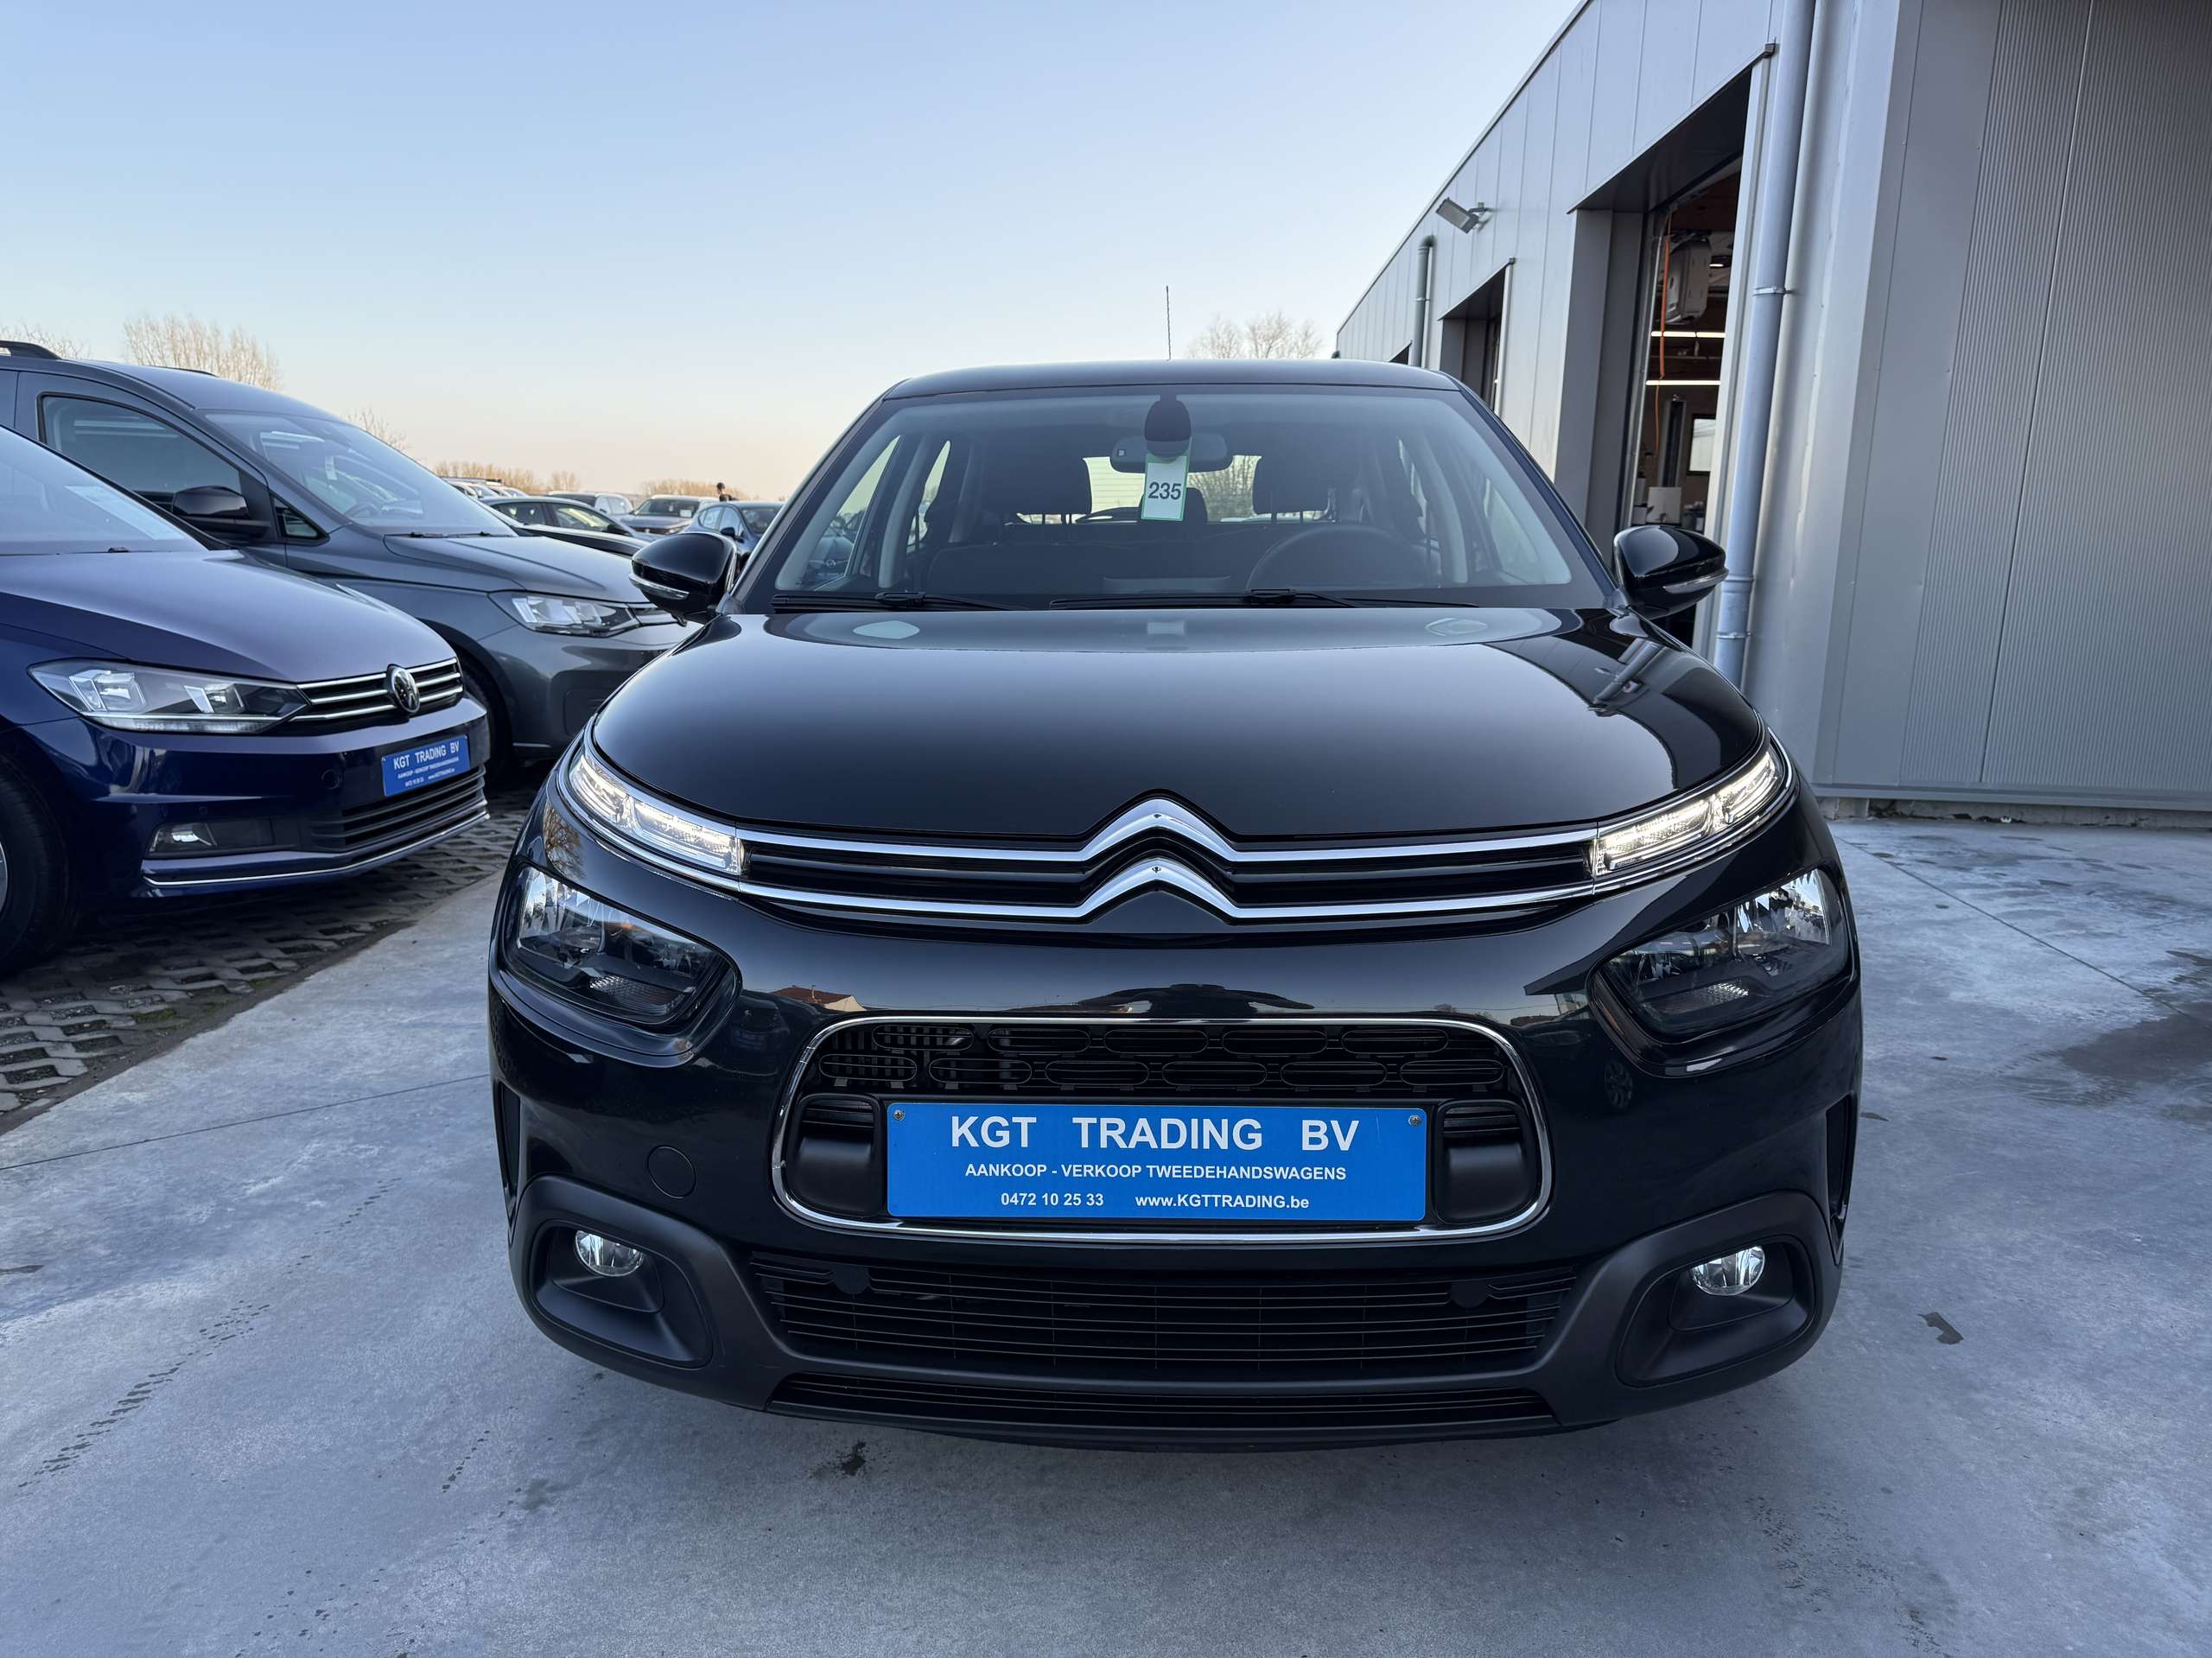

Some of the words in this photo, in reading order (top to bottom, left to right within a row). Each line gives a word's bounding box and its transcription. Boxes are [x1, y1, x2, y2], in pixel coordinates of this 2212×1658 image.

[1147, 481, 1181, 500] 235
[393, 754, 410, 770] KGT
[415, 745, 447, 763] TRADING
[450, 740, 460, 754] BV
[952, 1116, 1037, 1148] KGT
[1072, 1117, 1262, 1151] TRADING
[1301, 1120, 1359, 1151] BV
[964, 1164, 1047, 1177] AANKOOP
[1060, 1165, 1142, 1178] VERKOOP
[1146, 1165, 1347, 1180] TWEEDEHANDSWAGENS
[1001, 1192, 1037, 1206] 0472
[1041, 1192, 1059, 1206] 10
[1064, 1192, 1082, 1206] 25
[1086, 1193, 1104, 1206] 33
[1135, 1194, 1310, 1209] www.KGTTRADING.be
